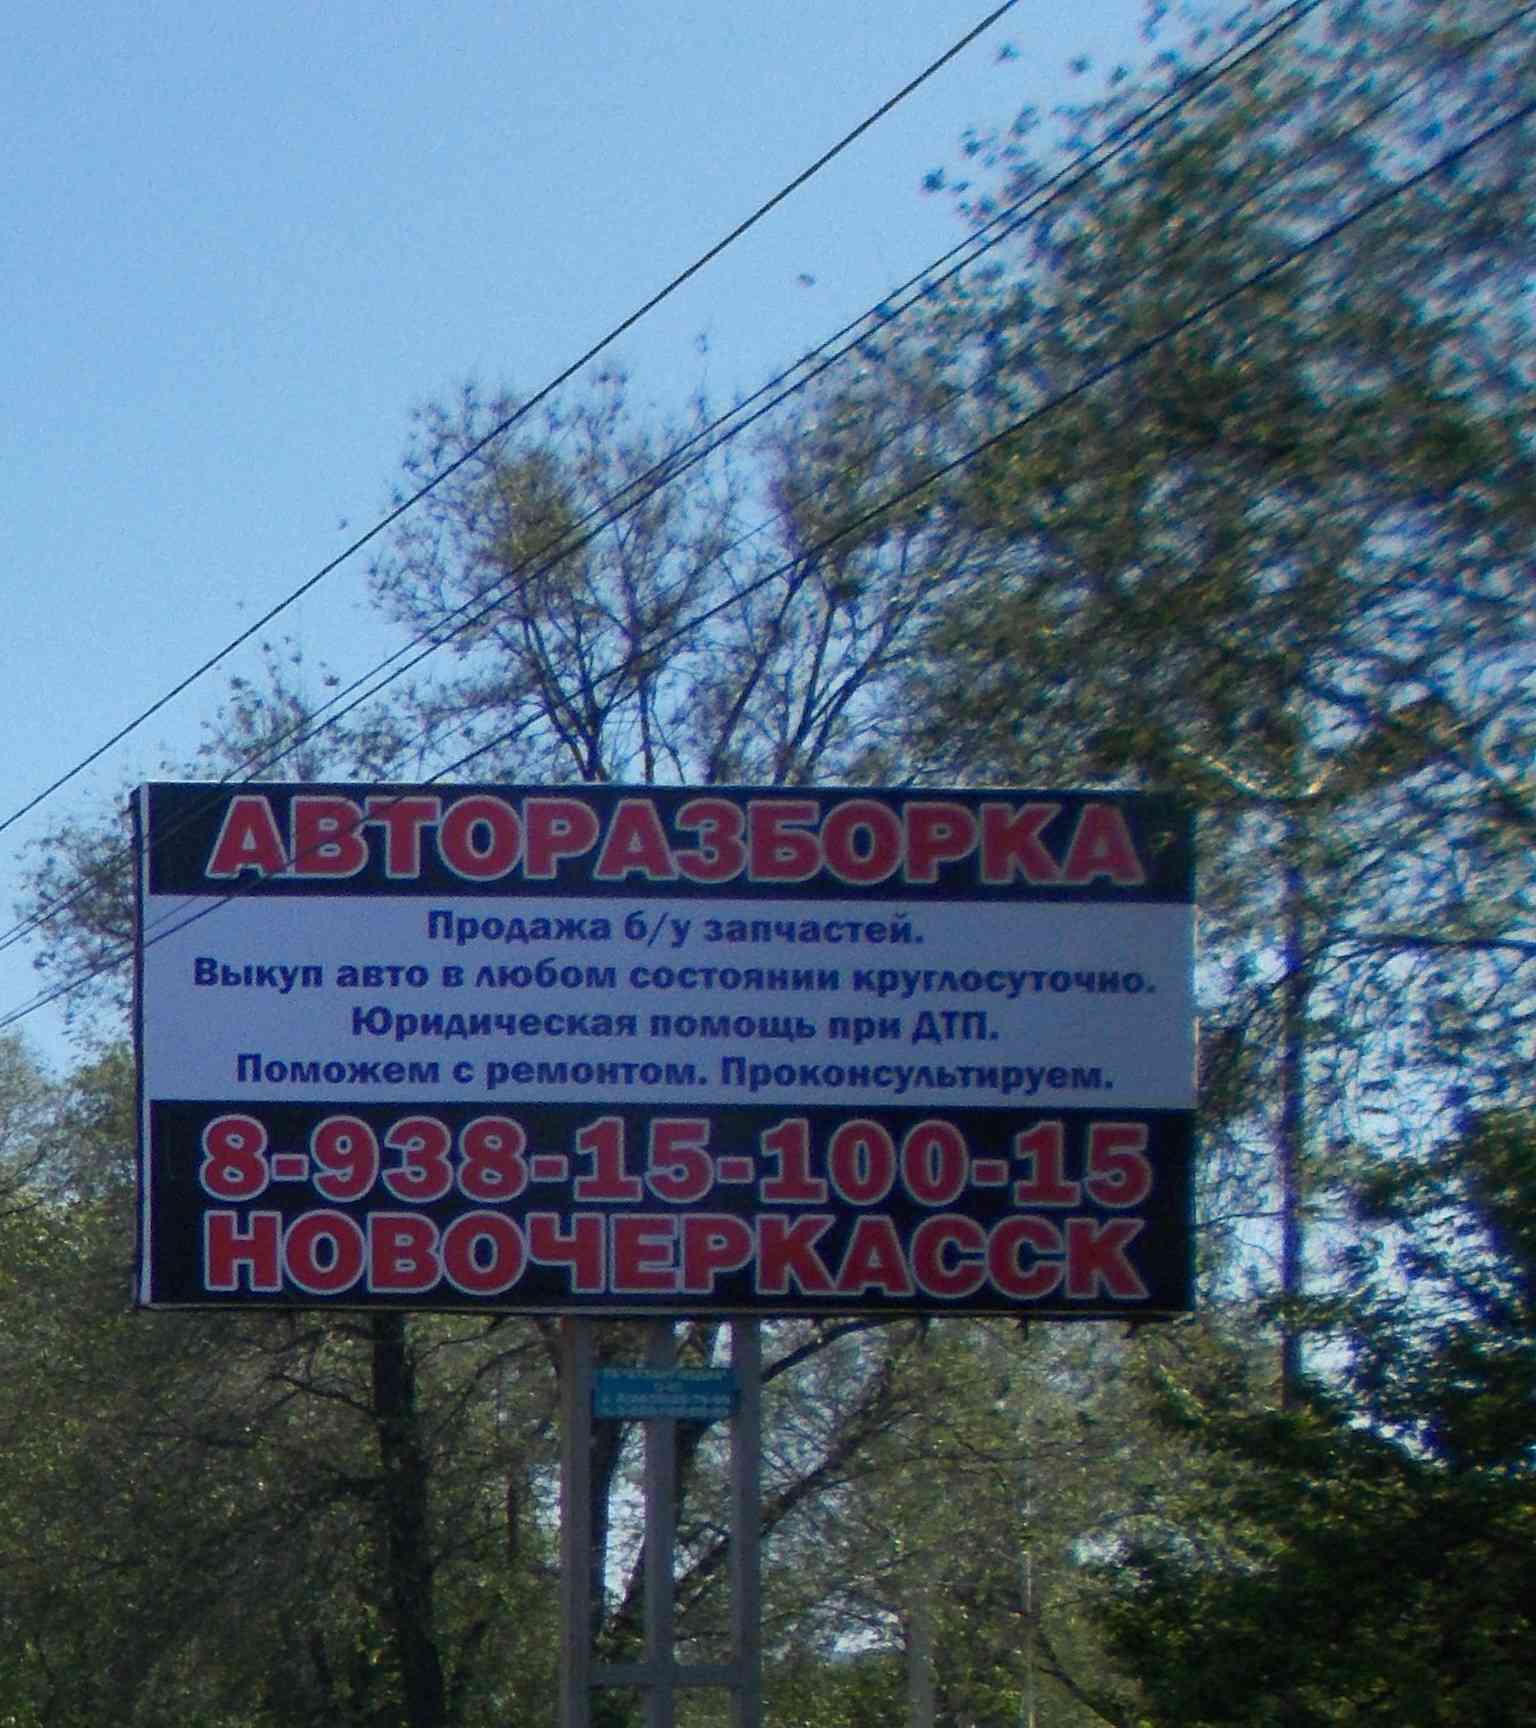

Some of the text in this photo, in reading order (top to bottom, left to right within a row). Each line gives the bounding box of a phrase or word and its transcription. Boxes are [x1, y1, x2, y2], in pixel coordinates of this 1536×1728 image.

[205, 795, 1147, 886] АВТОРАЗБОРКА
[428, 910, 924, 949] Продажа б/у запчастей.
[194, 957, 1156, 999] Выкуп авто в любом состоянии круглосуточно.
[351, 1006, 999, 1045] Юридическая помощь при ДТП.
[236, 1053, 1114, 1095] Поможем с ремонтом. Проконсультируем.
[200, 1114, 1153, 1206] 8-938-15-100-15
[203, 1210, 1147, 1298] НОВОЧЕРКАССК
